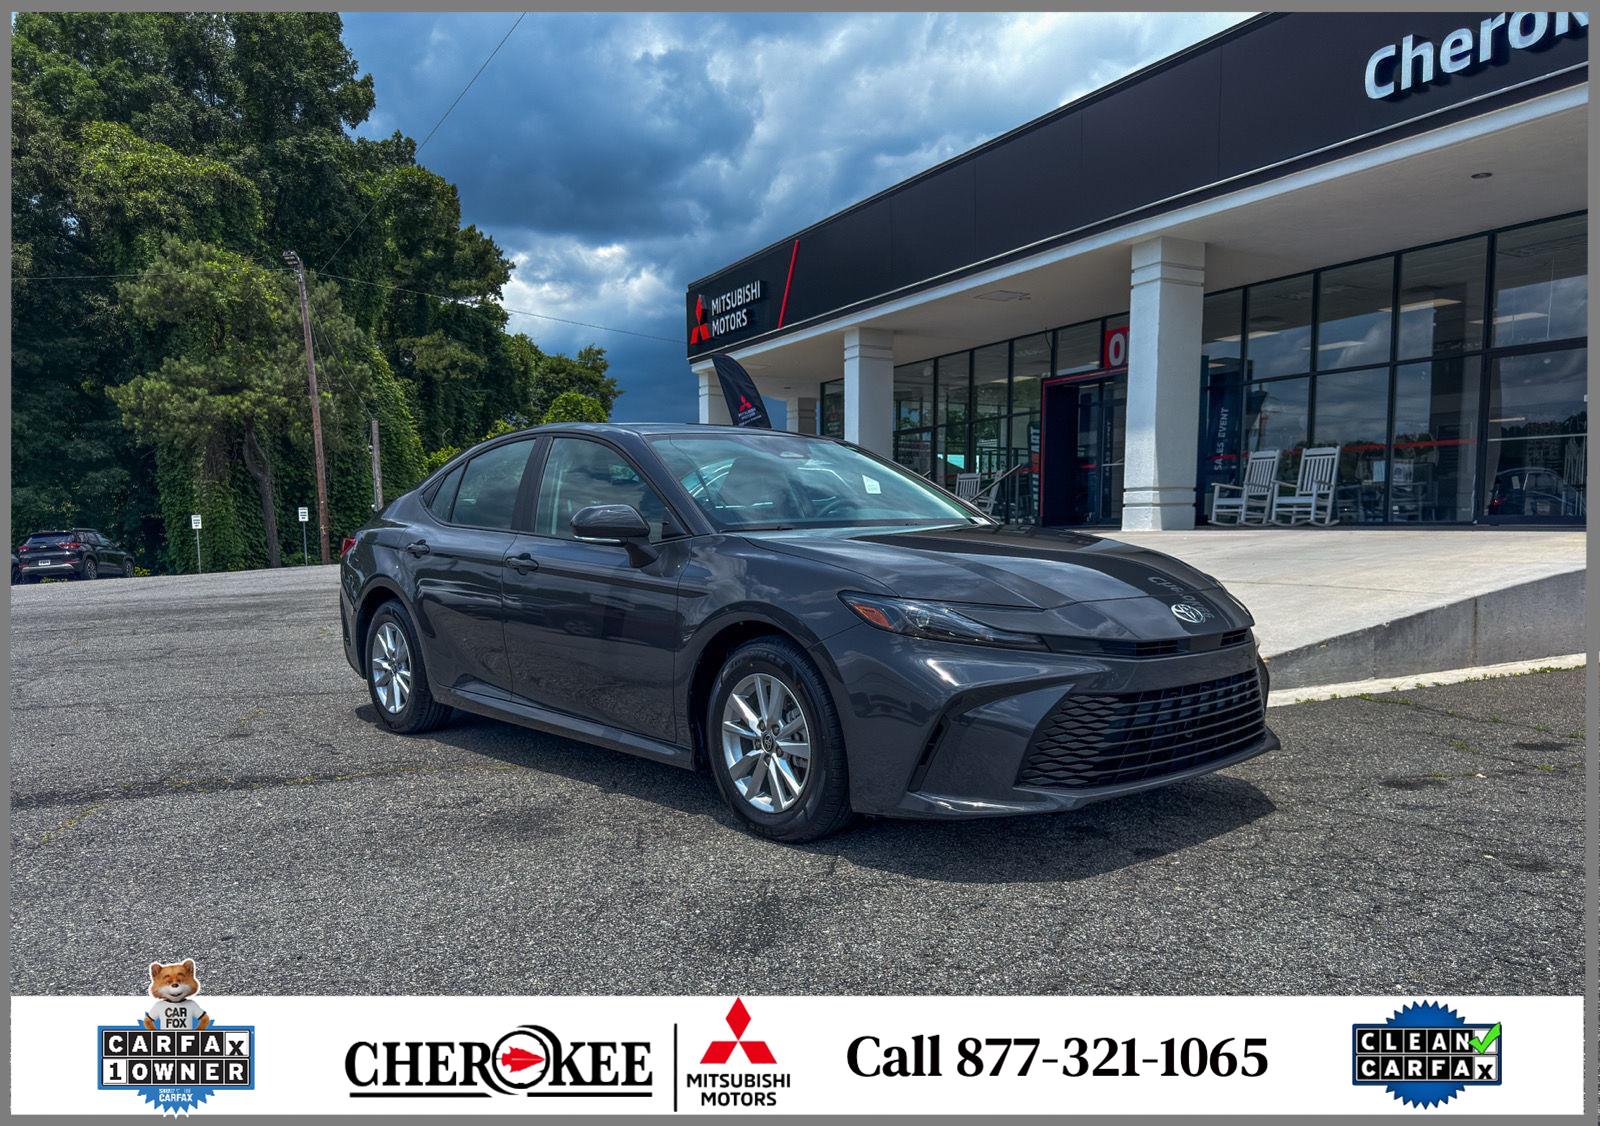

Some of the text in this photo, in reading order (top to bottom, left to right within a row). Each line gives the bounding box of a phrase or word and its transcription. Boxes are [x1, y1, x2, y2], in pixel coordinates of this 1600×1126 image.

[712, 280, 761, 316] MITSUBISHI
[712, 309, 748, 336] MOTORS
[1109, 333, 1129, 366] O
